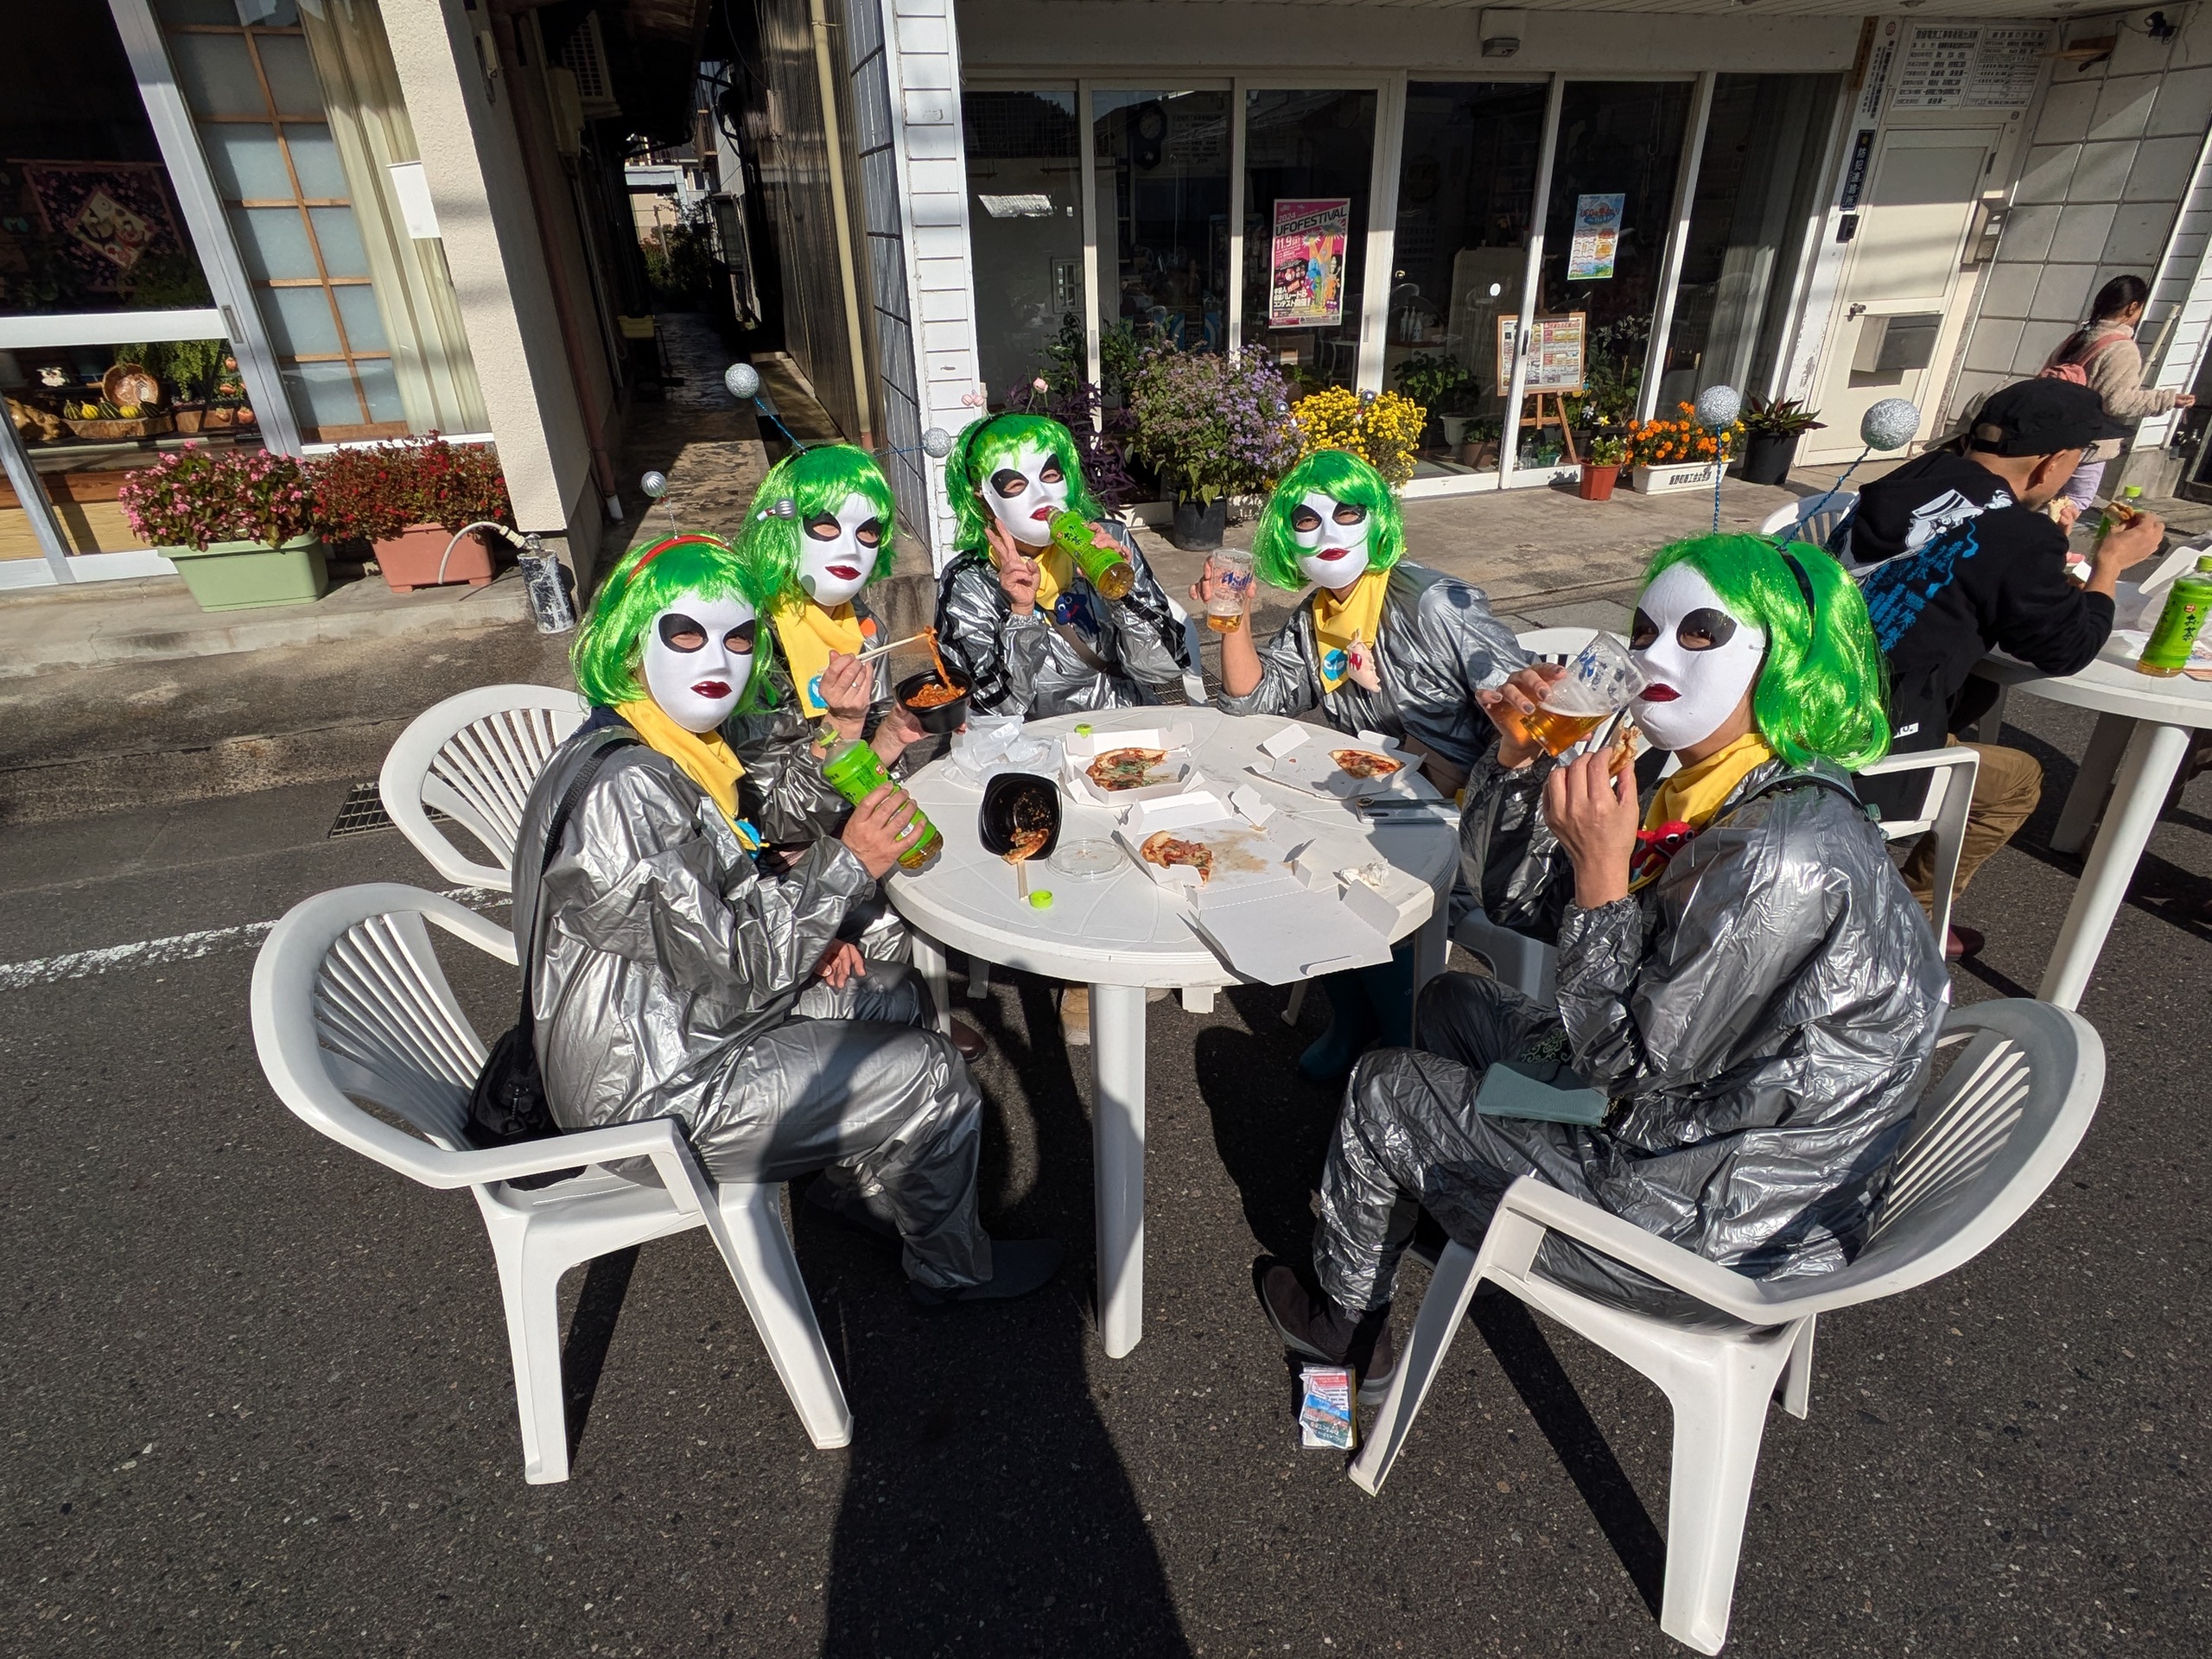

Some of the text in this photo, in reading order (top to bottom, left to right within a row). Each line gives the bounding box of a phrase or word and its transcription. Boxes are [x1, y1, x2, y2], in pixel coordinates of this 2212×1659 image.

[1278, 212, 1296, 223] 2024
[1276, 235, 1293, 251] 11.9
[2182, 613, 2200, 642] お茶
